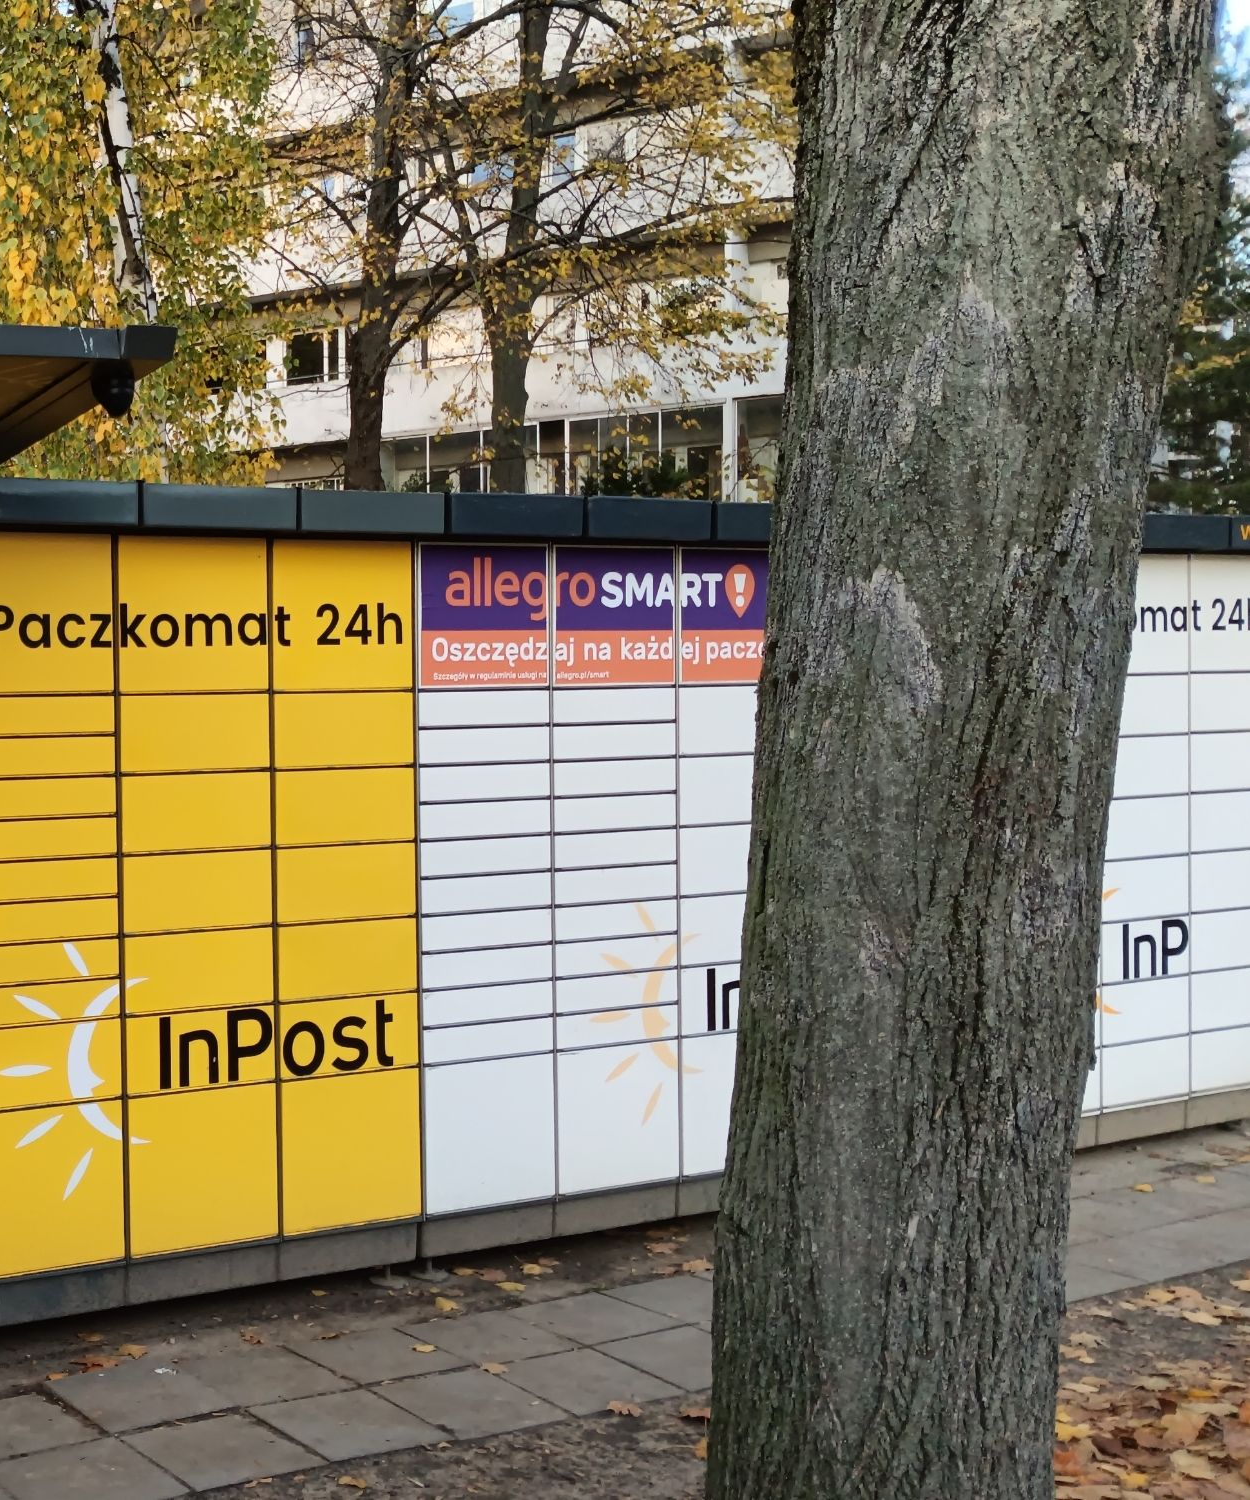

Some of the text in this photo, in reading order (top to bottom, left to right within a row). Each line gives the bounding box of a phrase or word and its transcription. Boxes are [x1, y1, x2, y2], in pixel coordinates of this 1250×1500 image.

[445, 557, 596, 621] allegro
[1131, 597, 1250, 633] mat 24
[317, 602, 403, 646] 24h
[583, 642, 612, 661] na
[1122, 919, 1189, 980] InP
[160, 1000, 394, 1090] InPost
